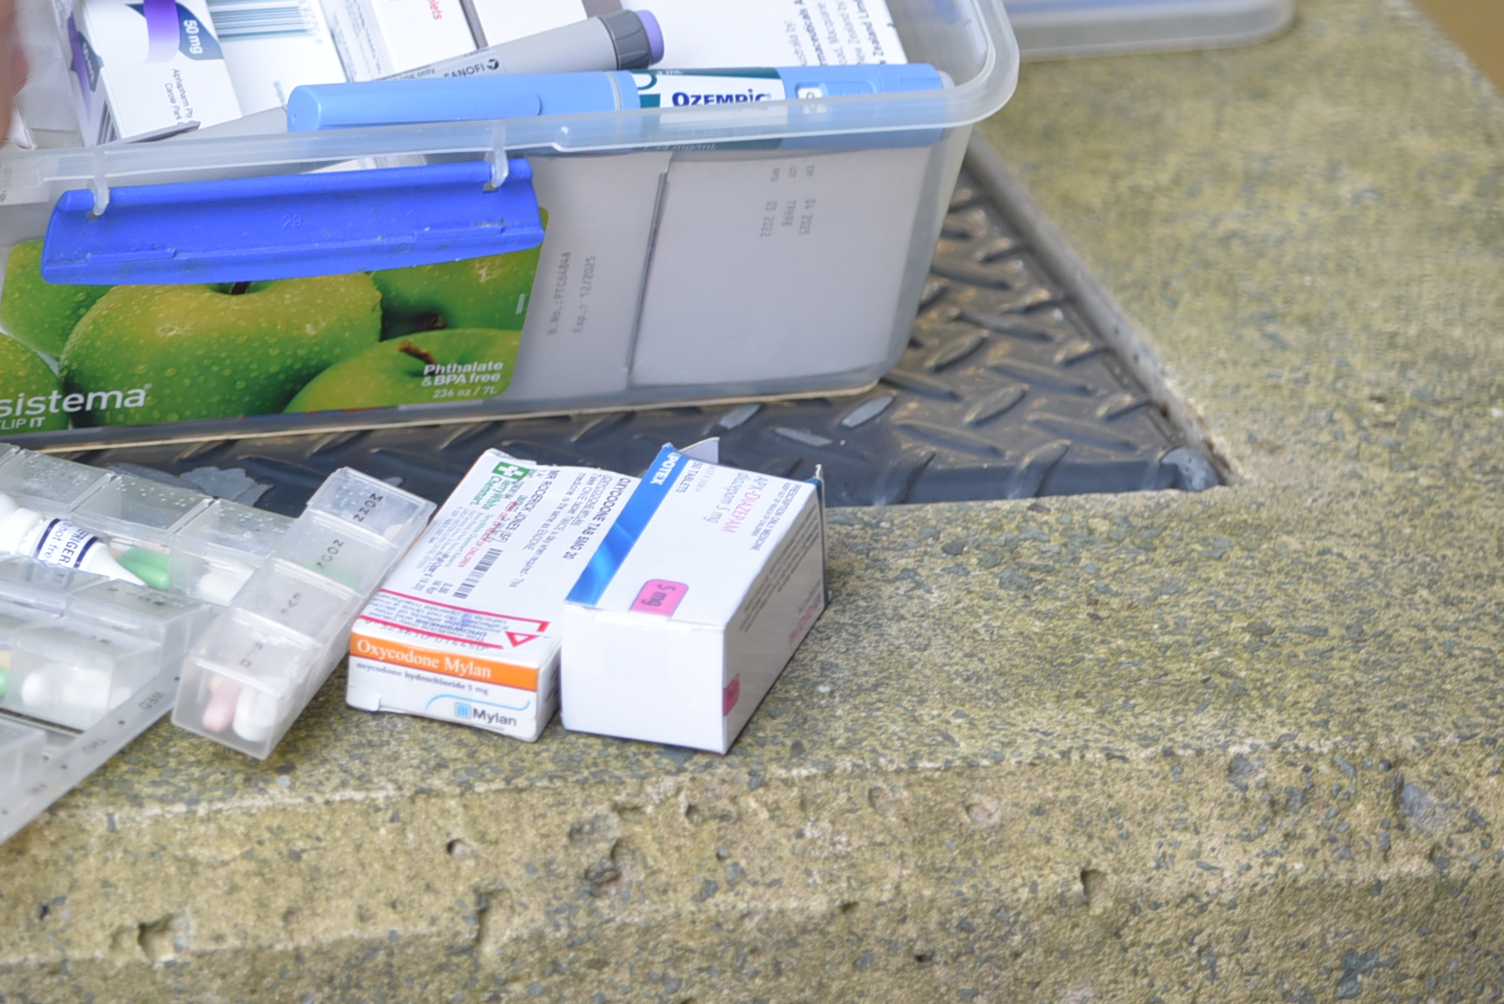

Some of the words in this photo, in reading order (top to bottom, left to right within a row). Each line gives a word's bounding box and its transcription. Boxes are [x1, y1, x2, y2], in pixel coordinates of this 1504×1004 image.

[182, 16, 200, 36] 50
[185, 34, 204, 57] mg
[424, 361, 503, 377] Phthalate
[469, 370, 500, 385] free
[432, 387, 455, 399] 236
[457, 388, 473, 400] oz
[483, 386, 498, 396] 7L
[28, 416, 46, 428] IT
[690, 461, 703, 470] 50
[543, 469, 560, 480] MR
[584, 473, 601, 486] Take
[674, 468, 698, 493] TABLETS
[562, 472, 587, 496] medicine
[715, 471, 751, 505] diazepam
[478, 479, 514, 510] TerryWhite
[519, 480, 552, 512] RODERICK
[575, 486, 592, 500] ONE
[591, 477, 631, 522] OXYCODONE
[773, 483, 801, 516] PRESCRIPTION
[702, 510, 722, 523] mg
[715, 504, 731, 512] 5
[505, 511, 529, 531] JONES
[552, 513, 572, 531] TWICE
[581, 521, 600, 535] TAB
[765, 516, 780, 528] ONLY
[522, 528, 547, 551] ENDONE
[539, 534, 556, 544] day
[570, 535, 590, 551] 5MG
[750, 528, 772, 551] MEDICINE
[561, 550, 578, 560] 20
[507, 577, 524, 588] This
[656, 583, 676, 591] 5
[639, 590, 668, 607] mg
[356, 638, 440, 669] Oxycodone
[443, 656, 491, 680] Mylan
[356, 661, 401, 679] oxycodone
[404, 672, 465, 690] hydrochloride
[474, 686, 489, 696] mg
[137, 688, 165, 712] WED
[471, 707, 517, 728] Mylan
